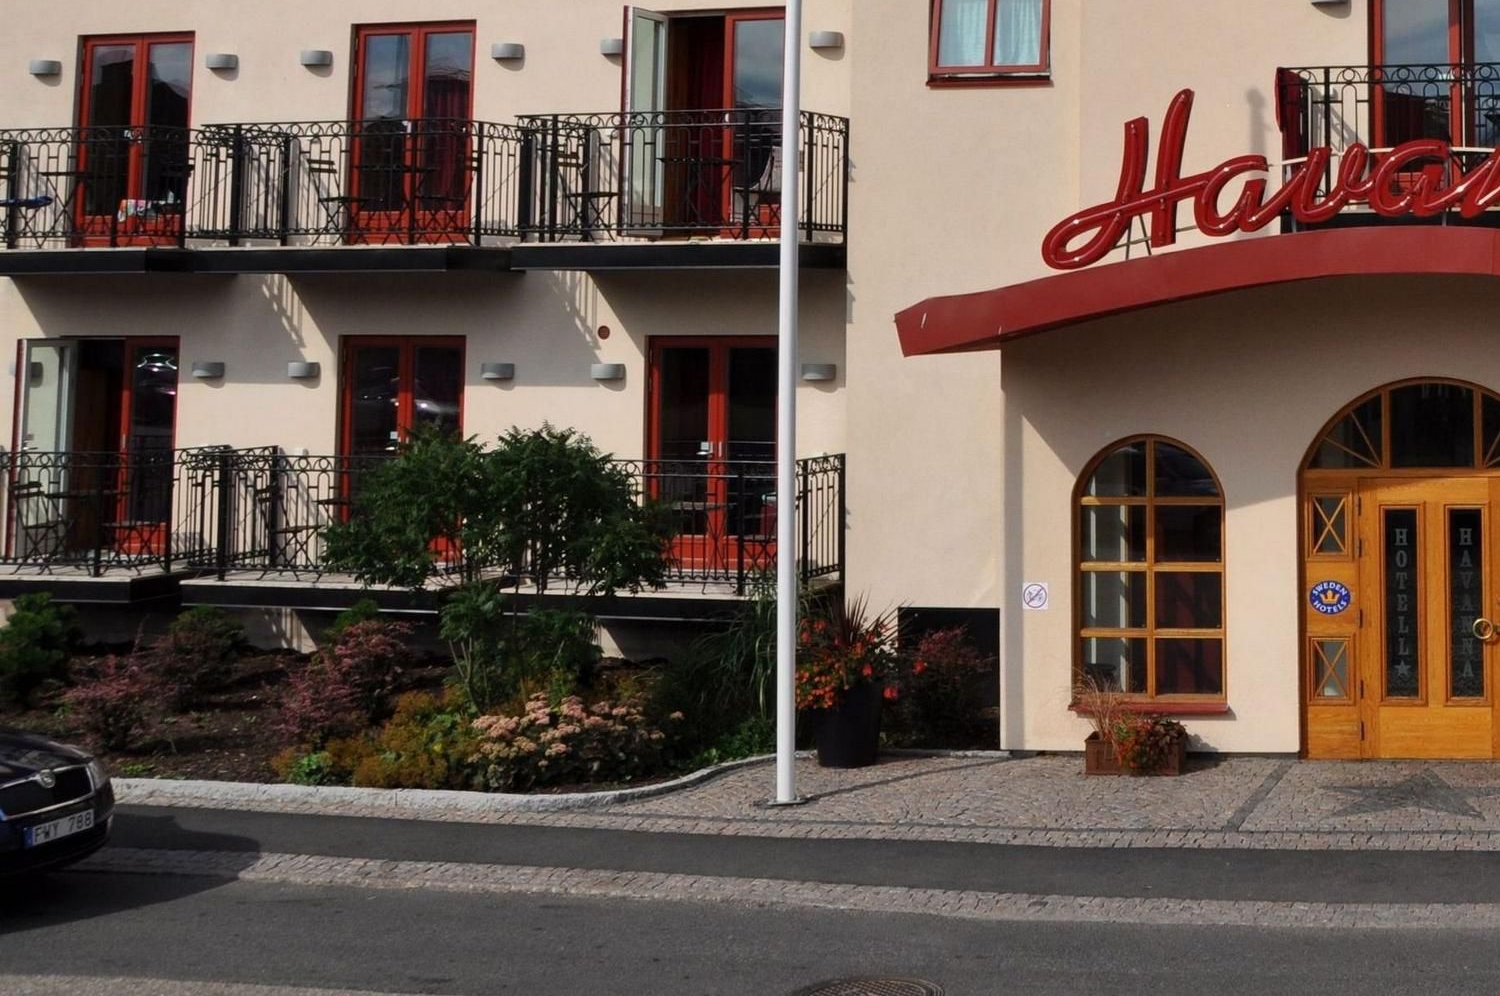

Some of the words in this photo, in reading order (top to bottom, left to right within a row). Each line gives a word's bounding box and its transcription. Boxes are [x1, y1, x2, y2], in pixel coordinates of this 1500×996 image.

[1312, 582, 1347, 595] SWEDEN
[1313, 600, 1347, 613] HOTELS
[1394, 528, 1409, 655] HOTELL
[1459, 528, 1474, 677] HAVANNA
